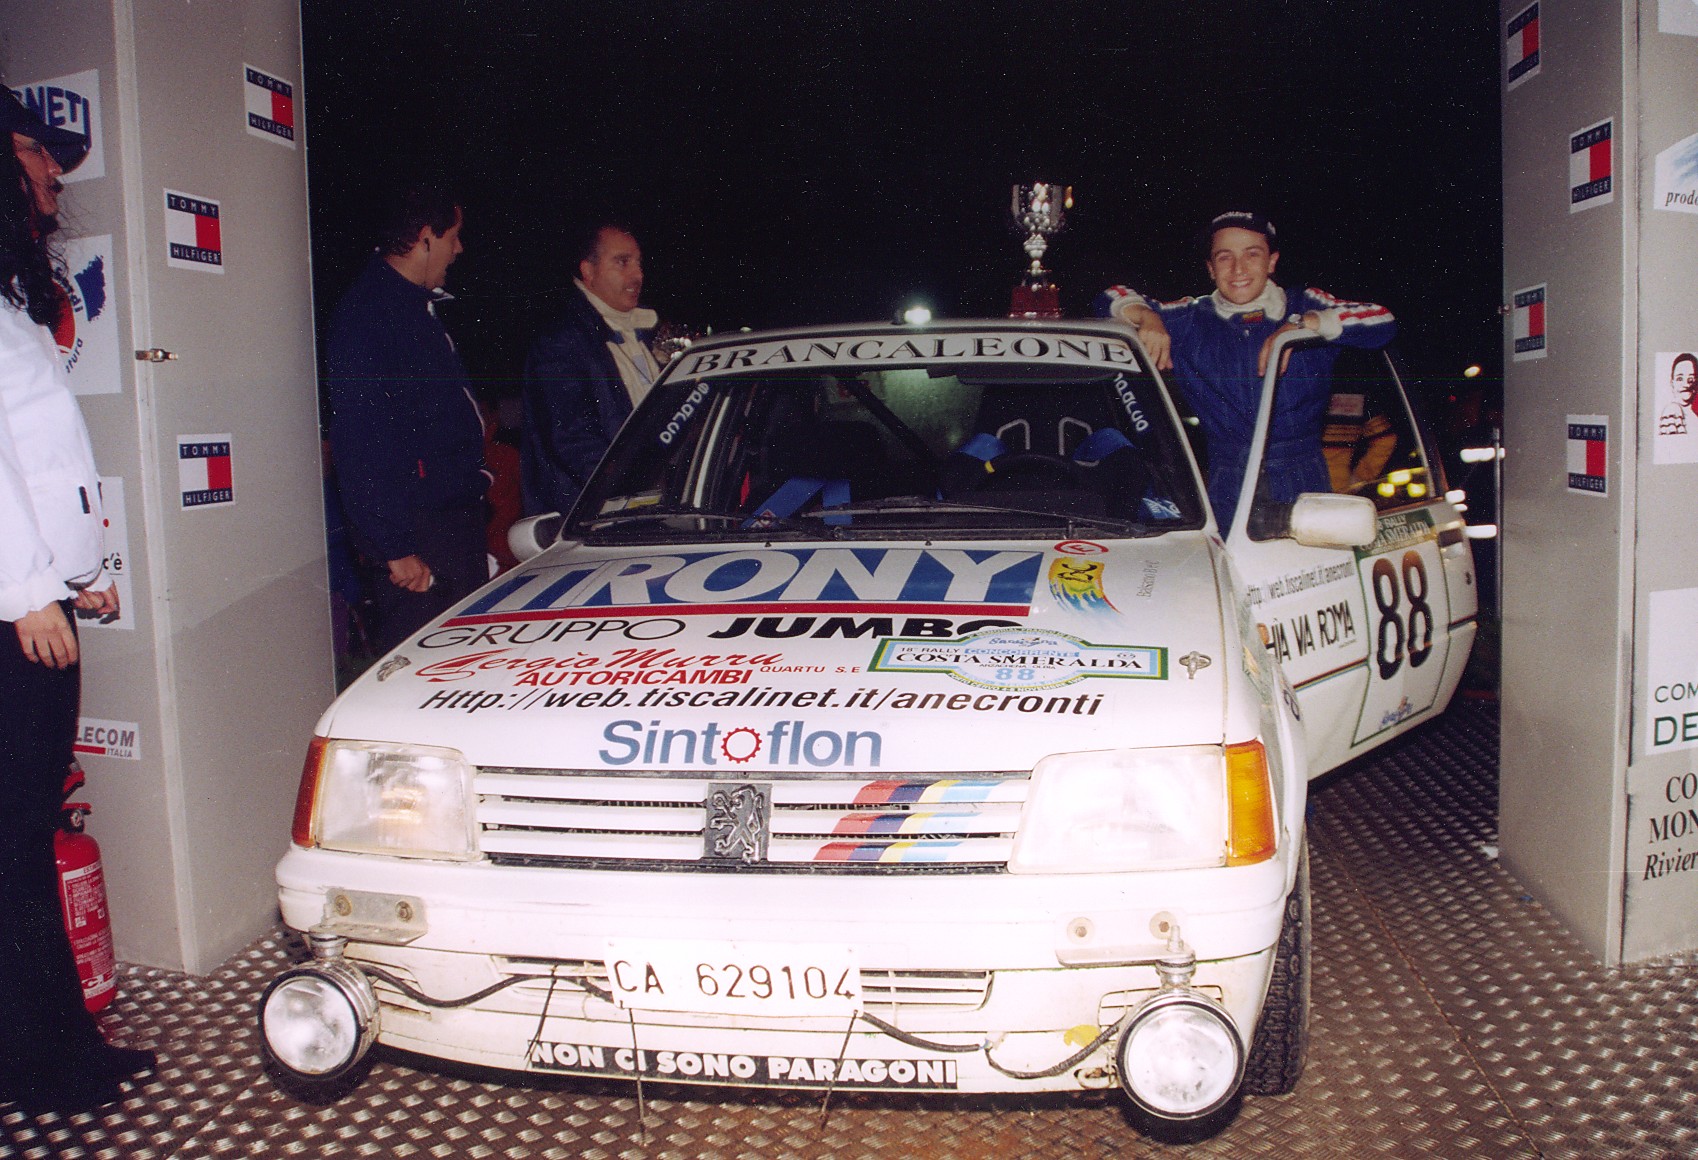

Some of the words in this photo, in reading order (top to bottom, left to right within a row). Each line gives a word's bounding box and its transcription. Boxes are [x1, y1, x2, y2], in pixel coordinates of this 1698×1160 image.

[170, 196, 216, 216] TOMMY
[173, 247, 220, 263] HILFIGER
[689, 337, 1135, 374] BRANCALEONE
[182, 445, 227, 456] TOMMY
[185, 490, 230, 504] HILFIGER
[487, 548, 1043, 615] TRONY
[1317, 599, 1356, 648] ROMA
[1372, 551, 1433, 680] 88
[417, 618, 687, 649] GRUPPO
[604, 647, 784, 668] Murru
[896, 653, 981, 663] COSTA
[989, 654, 1142, 668] SMERALDA
[512, 669, 753, 686] AUTORICAMBI
[760, 665, 826, 673] QUARTU
[995, 668, 1035, 680] 88
[419, 688, 1104, 715] Http://web.tiscalinet.it/anecronti
[1653, 712, 1698, 746] DE
[107, 748, 133, 758] ITALIA
[1666, 773, 1698, 803] CO
[613, 959, 664, 995] CA
[695, 962, 856, 1000] 629104
[530, 1041, 605, 1068] NON
[614, 1049, 647, 1072] CI
[656, 1052, 757, 1079] SONO
[768, 1058, 957, 1084] PARAGONI
